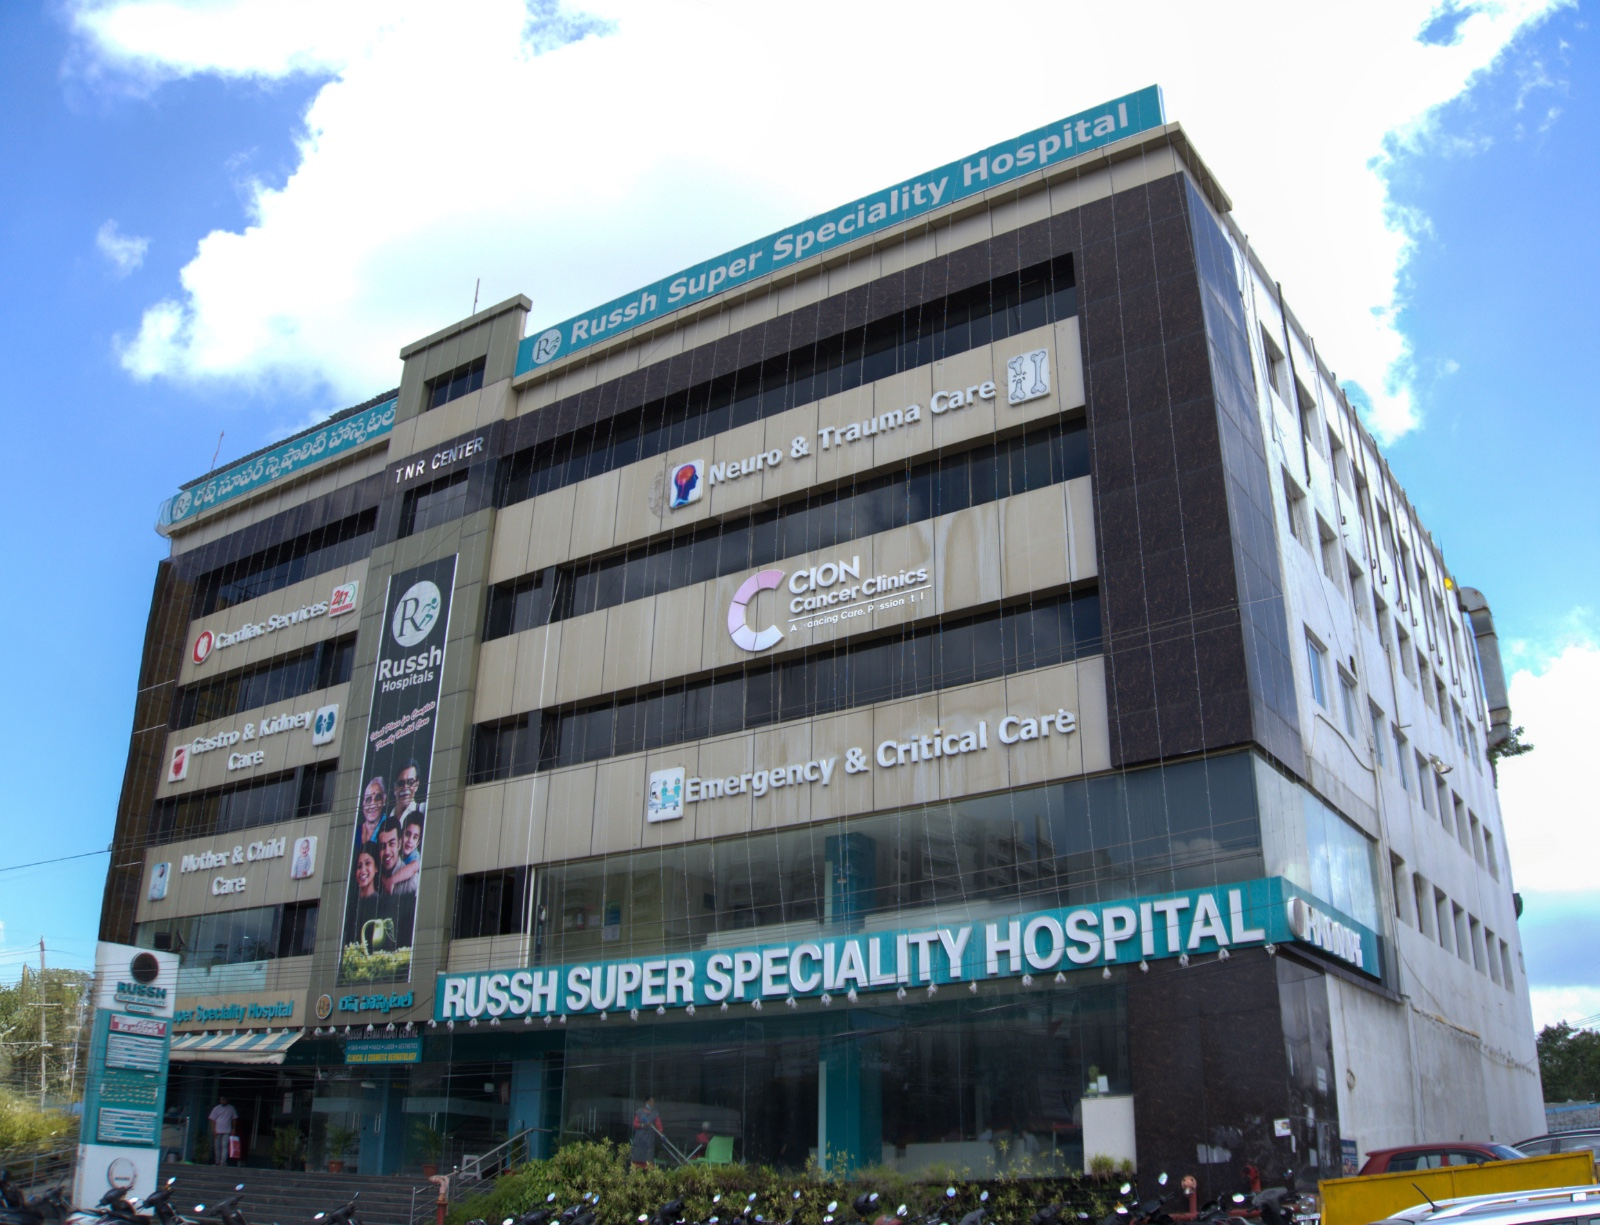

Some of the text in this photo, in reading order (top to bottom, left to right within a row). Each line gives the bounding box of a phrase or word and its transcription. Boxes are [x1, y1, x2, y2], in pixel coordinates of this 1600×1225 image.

[570, 102, 1129, 344] Russh Super Speciality Hospital
[709, 380, 997, 487] Neuro & Trauma Care
[395, 436, 485, 484] TNR CENTER
[788, 555, 861, 595] CION
[788, 568, 929, 614] Cancer Clinics
[214, 600, 329, 651] Cardiac Services
[378, 645, 442, 681] Russh
[381, 670, 434, 693] Hospitals
[191, 709, 316, 755] Gastro & Kidney
[227, 750, 265, 772] Care
[684, 709, 1076, 805] Emergency & Critical Care
[180, 836, 285, 873] Mother & Child
[211, 876, 246, 896] Care
[443, 969, 559, 1019] RUSSH
[565, 957, 696, 1012] SUPER
[702, 924, 974, 1002] SPECIALITY
[984, 889, 1266, 976] HOSPITAL
[116, 981, 167, 999] RUSSH
[195, 1004, 247, 1025] Speciality
[247, 1000, 295, 1022] Hospital
[388, 1052, 417, 1061] DERMATOLOGY
